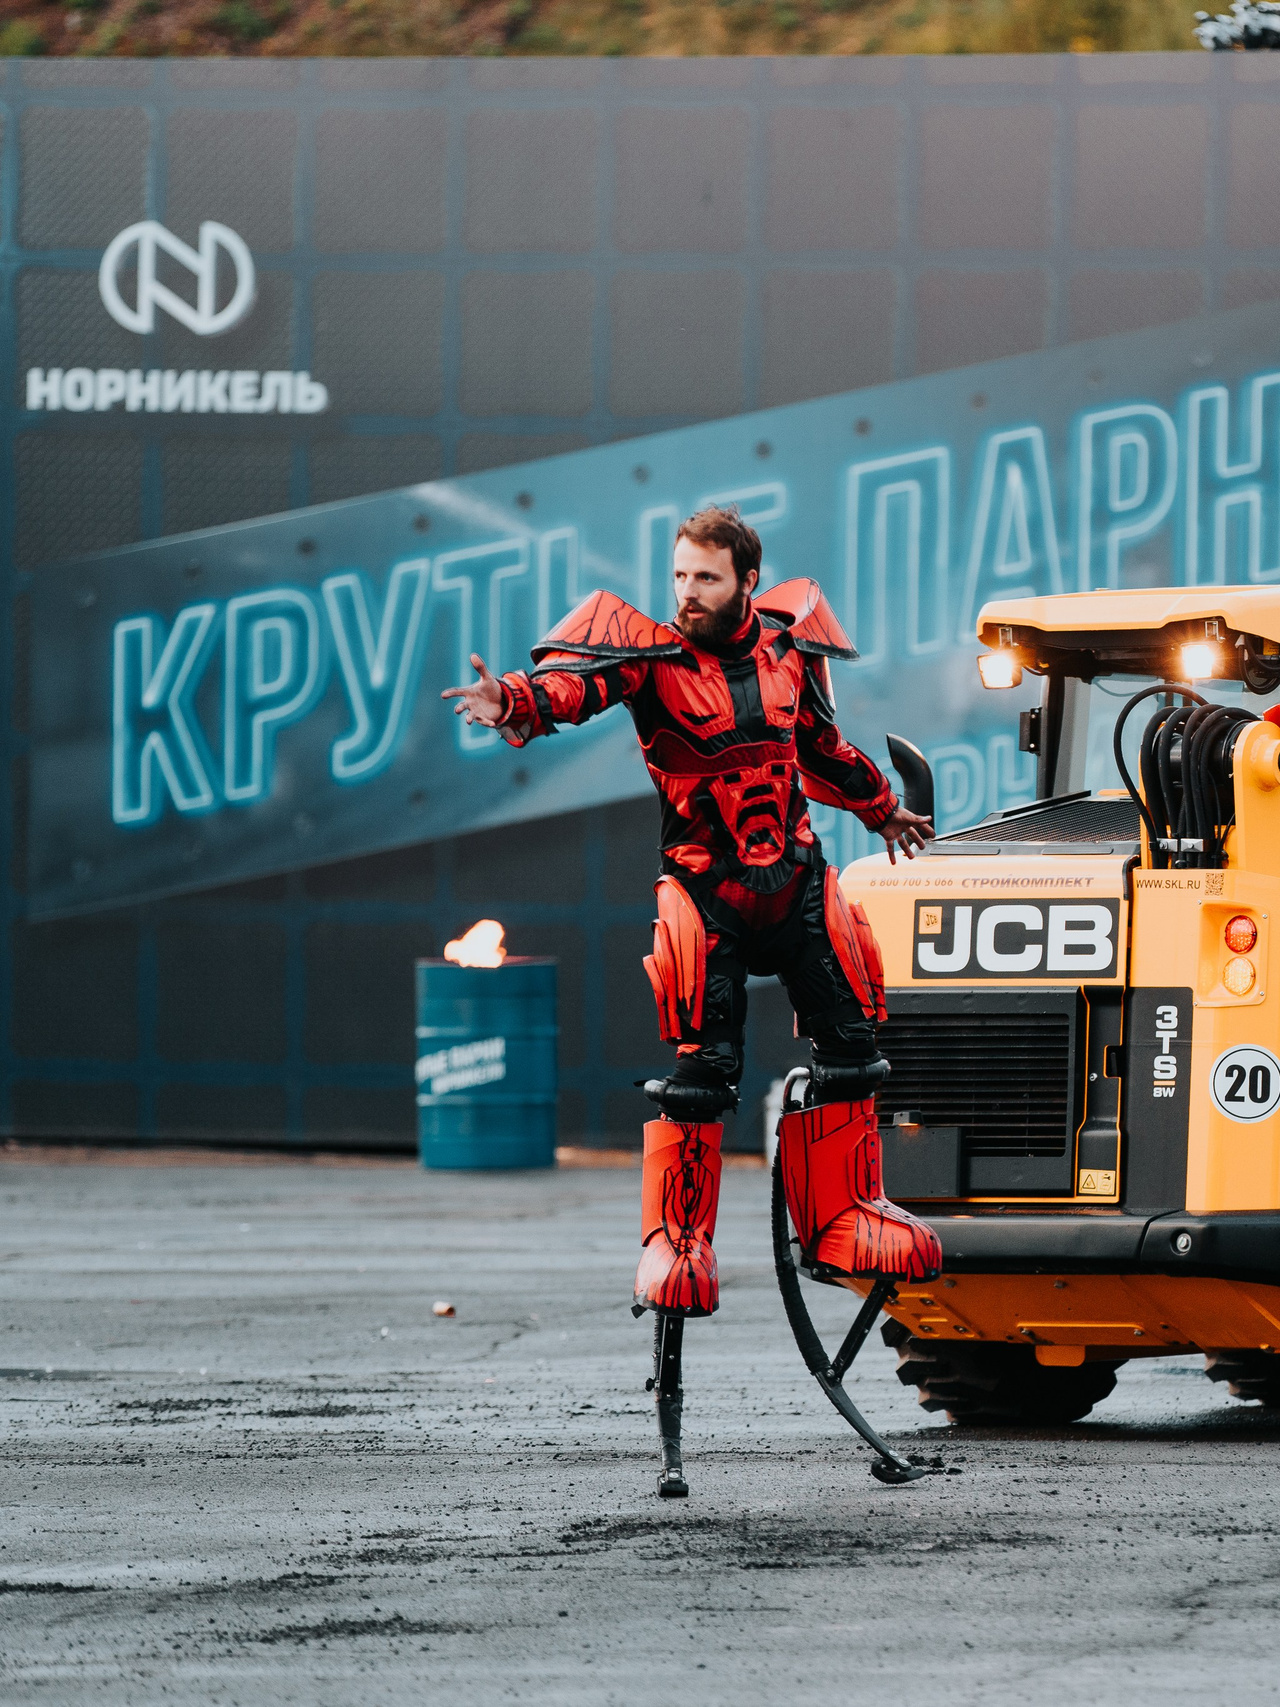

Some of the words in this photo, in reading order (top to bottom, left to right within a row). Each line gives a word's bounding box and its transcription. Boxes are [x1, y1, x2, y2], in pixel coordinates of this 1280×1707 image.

[26, 367, 328, 413] НОРНИКЕЛЬ
[869, 877, 877, 887] 8
[879, 877, 899, 887] 800
[902, 877, 922, 887] 700
[934, 877, 954, 887] 066
[961, 874, 1094, 889] СТРОЙКОМПЛЕКТ
[1136, 879, 1201, 889] WWW.SKL.RU
[917, 905, 1113, 972] JCB
[1153, 1087, 1175, 1097] 8W
[1224, 1064, 1271, 1103] 20
